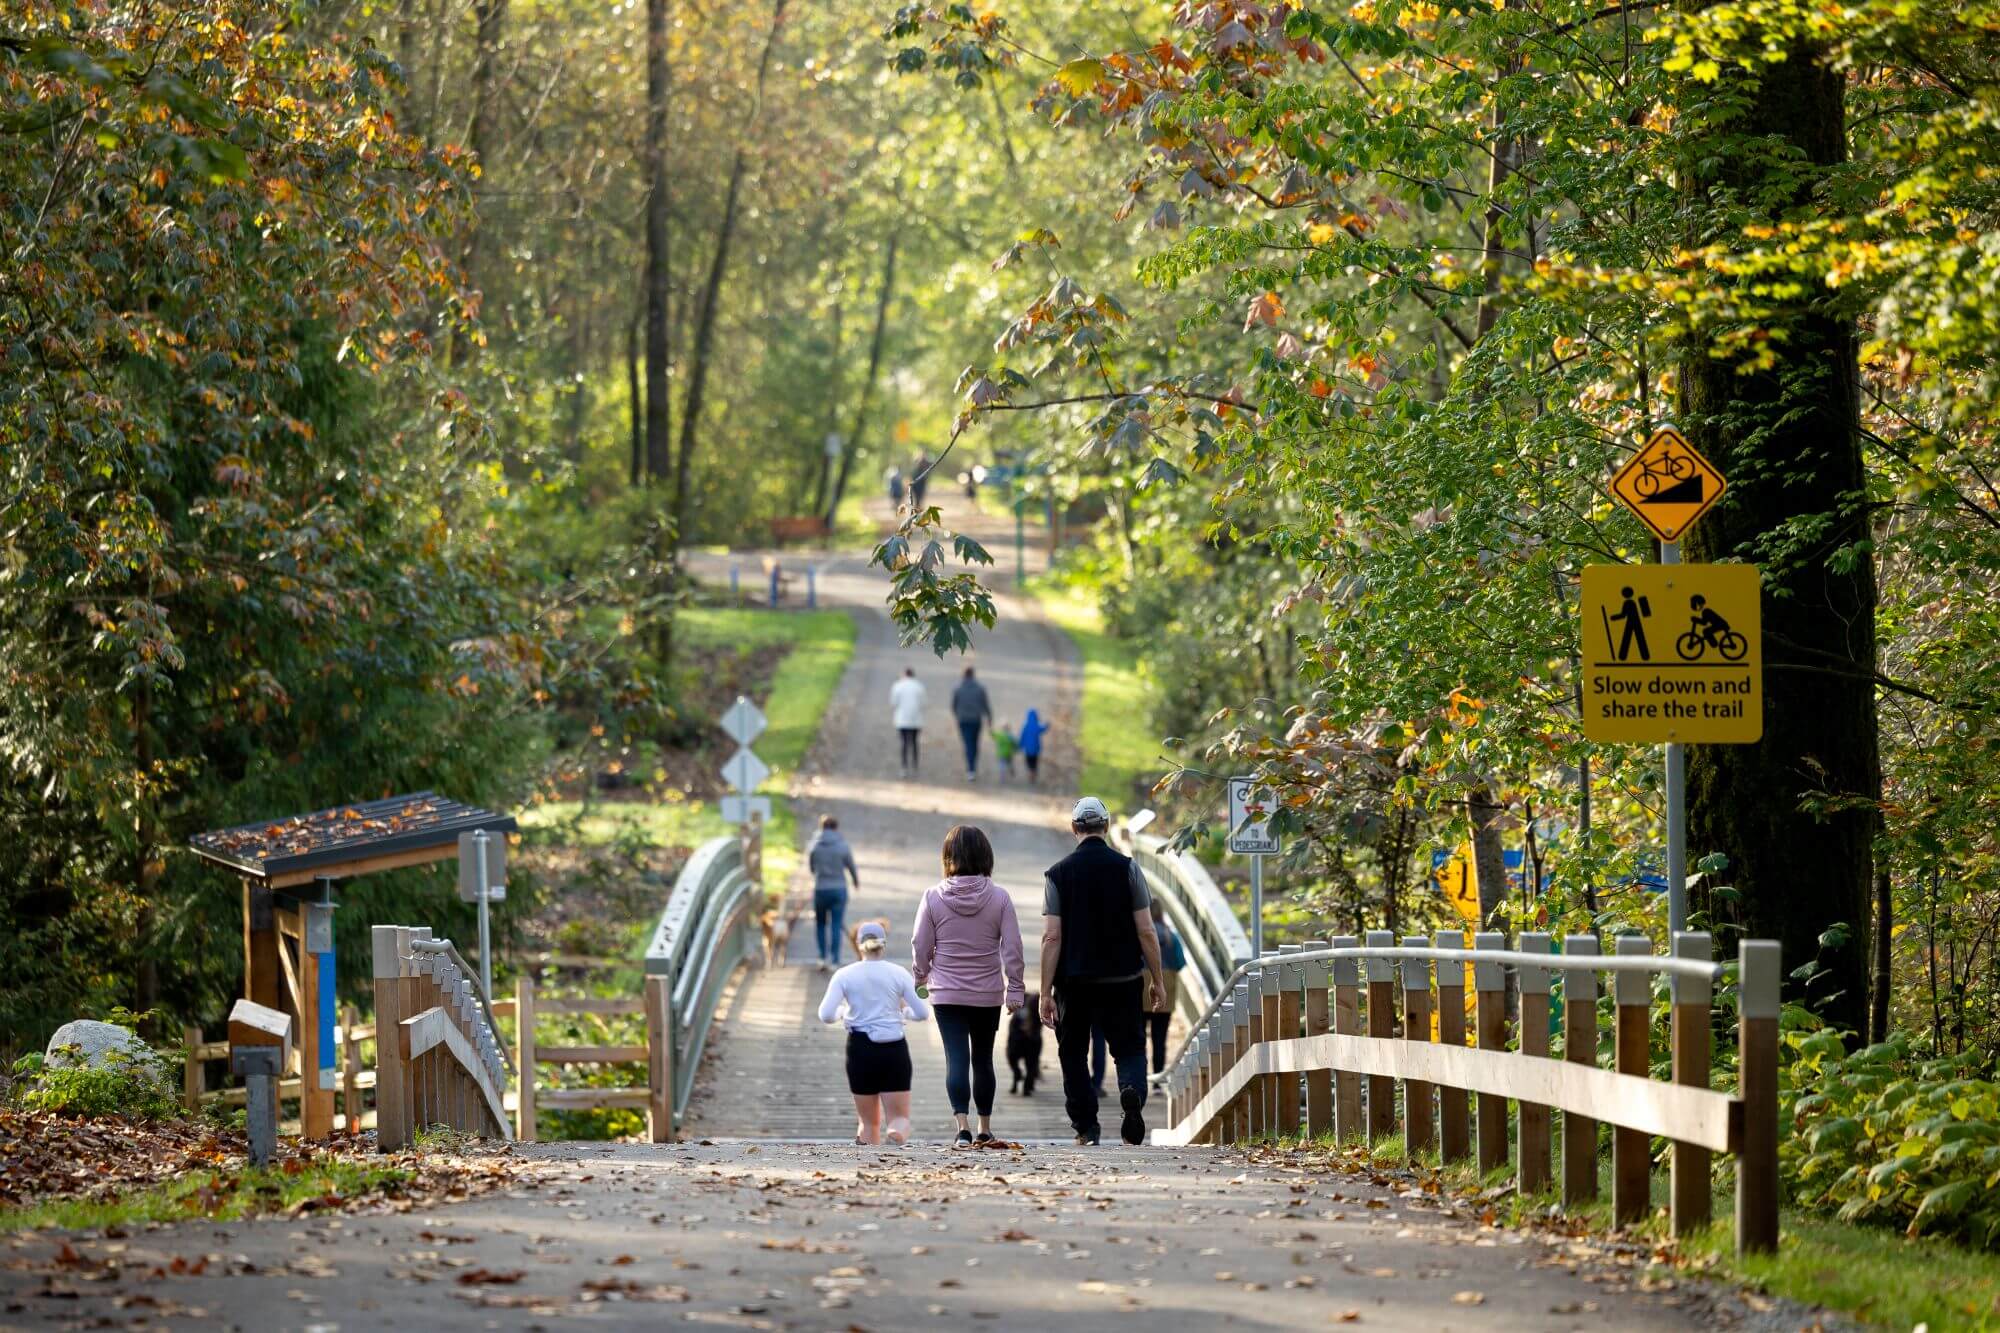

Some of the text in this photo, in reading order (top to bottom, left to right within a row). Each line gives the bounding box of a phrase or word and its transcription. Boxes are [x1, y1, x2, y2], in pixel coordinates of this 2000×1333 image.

[1593, 675, 1751, 694] Slow down and
[1602, 699, 1744, 718] share the trail
